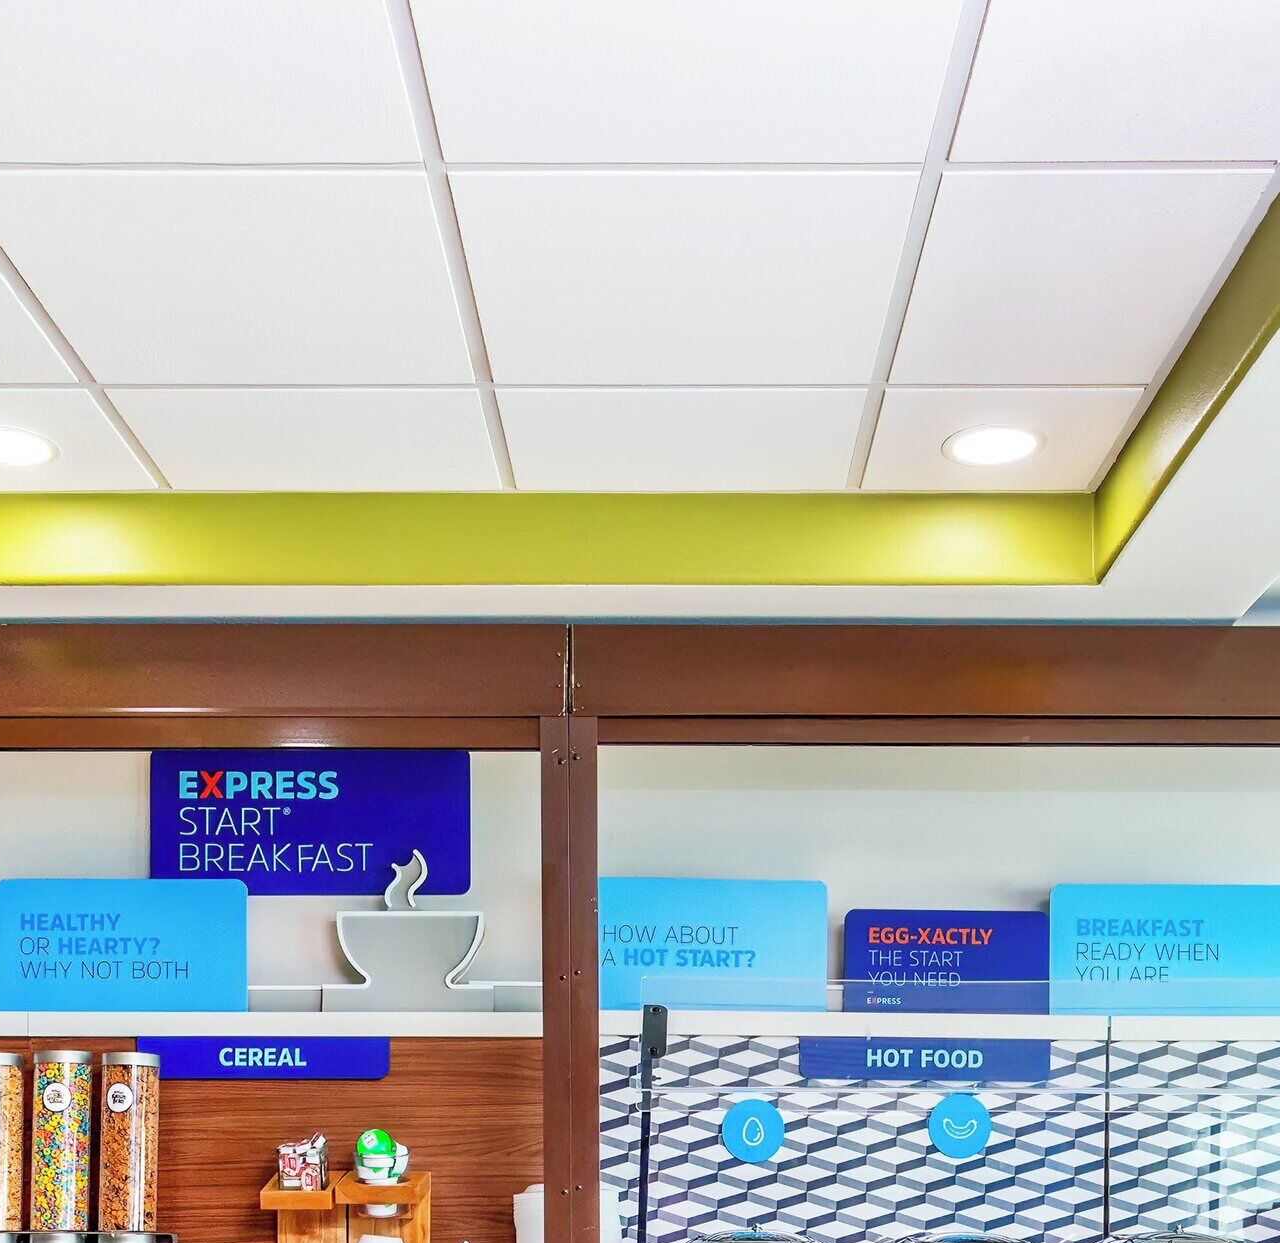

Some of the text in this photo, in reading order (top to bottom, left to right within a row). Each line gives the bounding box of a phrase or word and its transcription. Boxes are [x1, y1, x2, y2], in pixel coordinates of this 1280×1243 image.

[178, 770, 339, 800] EXPRESS
[178, 842, 374, 874] BREAKFAST
[20, 912, 121, 932] HEALTHY
[1076, 918, 1205, 938] BREAKFAST
[602, 923, 739, 946] HOW ABOUT
[868, 926, 994, 946] EGG-XACTLY
[20, 937, 161, 956] OR HEARTY?
[1076, 942, 1220, 962] READY WHEN
[601, 948, 757, 968] A HOT START?
[868, 949, 964, 968] THE START
[20, 961, 190, 980] WHY NOT BOTH
[868, 971, 962, 987] YOU NEED
[1075, 965, 1169, 983] YOU ARE
[866, 997, 902, 1005] EXPRESS
[218, 1046, 308, 1068] CEREAL
[866, 1049, 984, 1070] HOT FOOD
